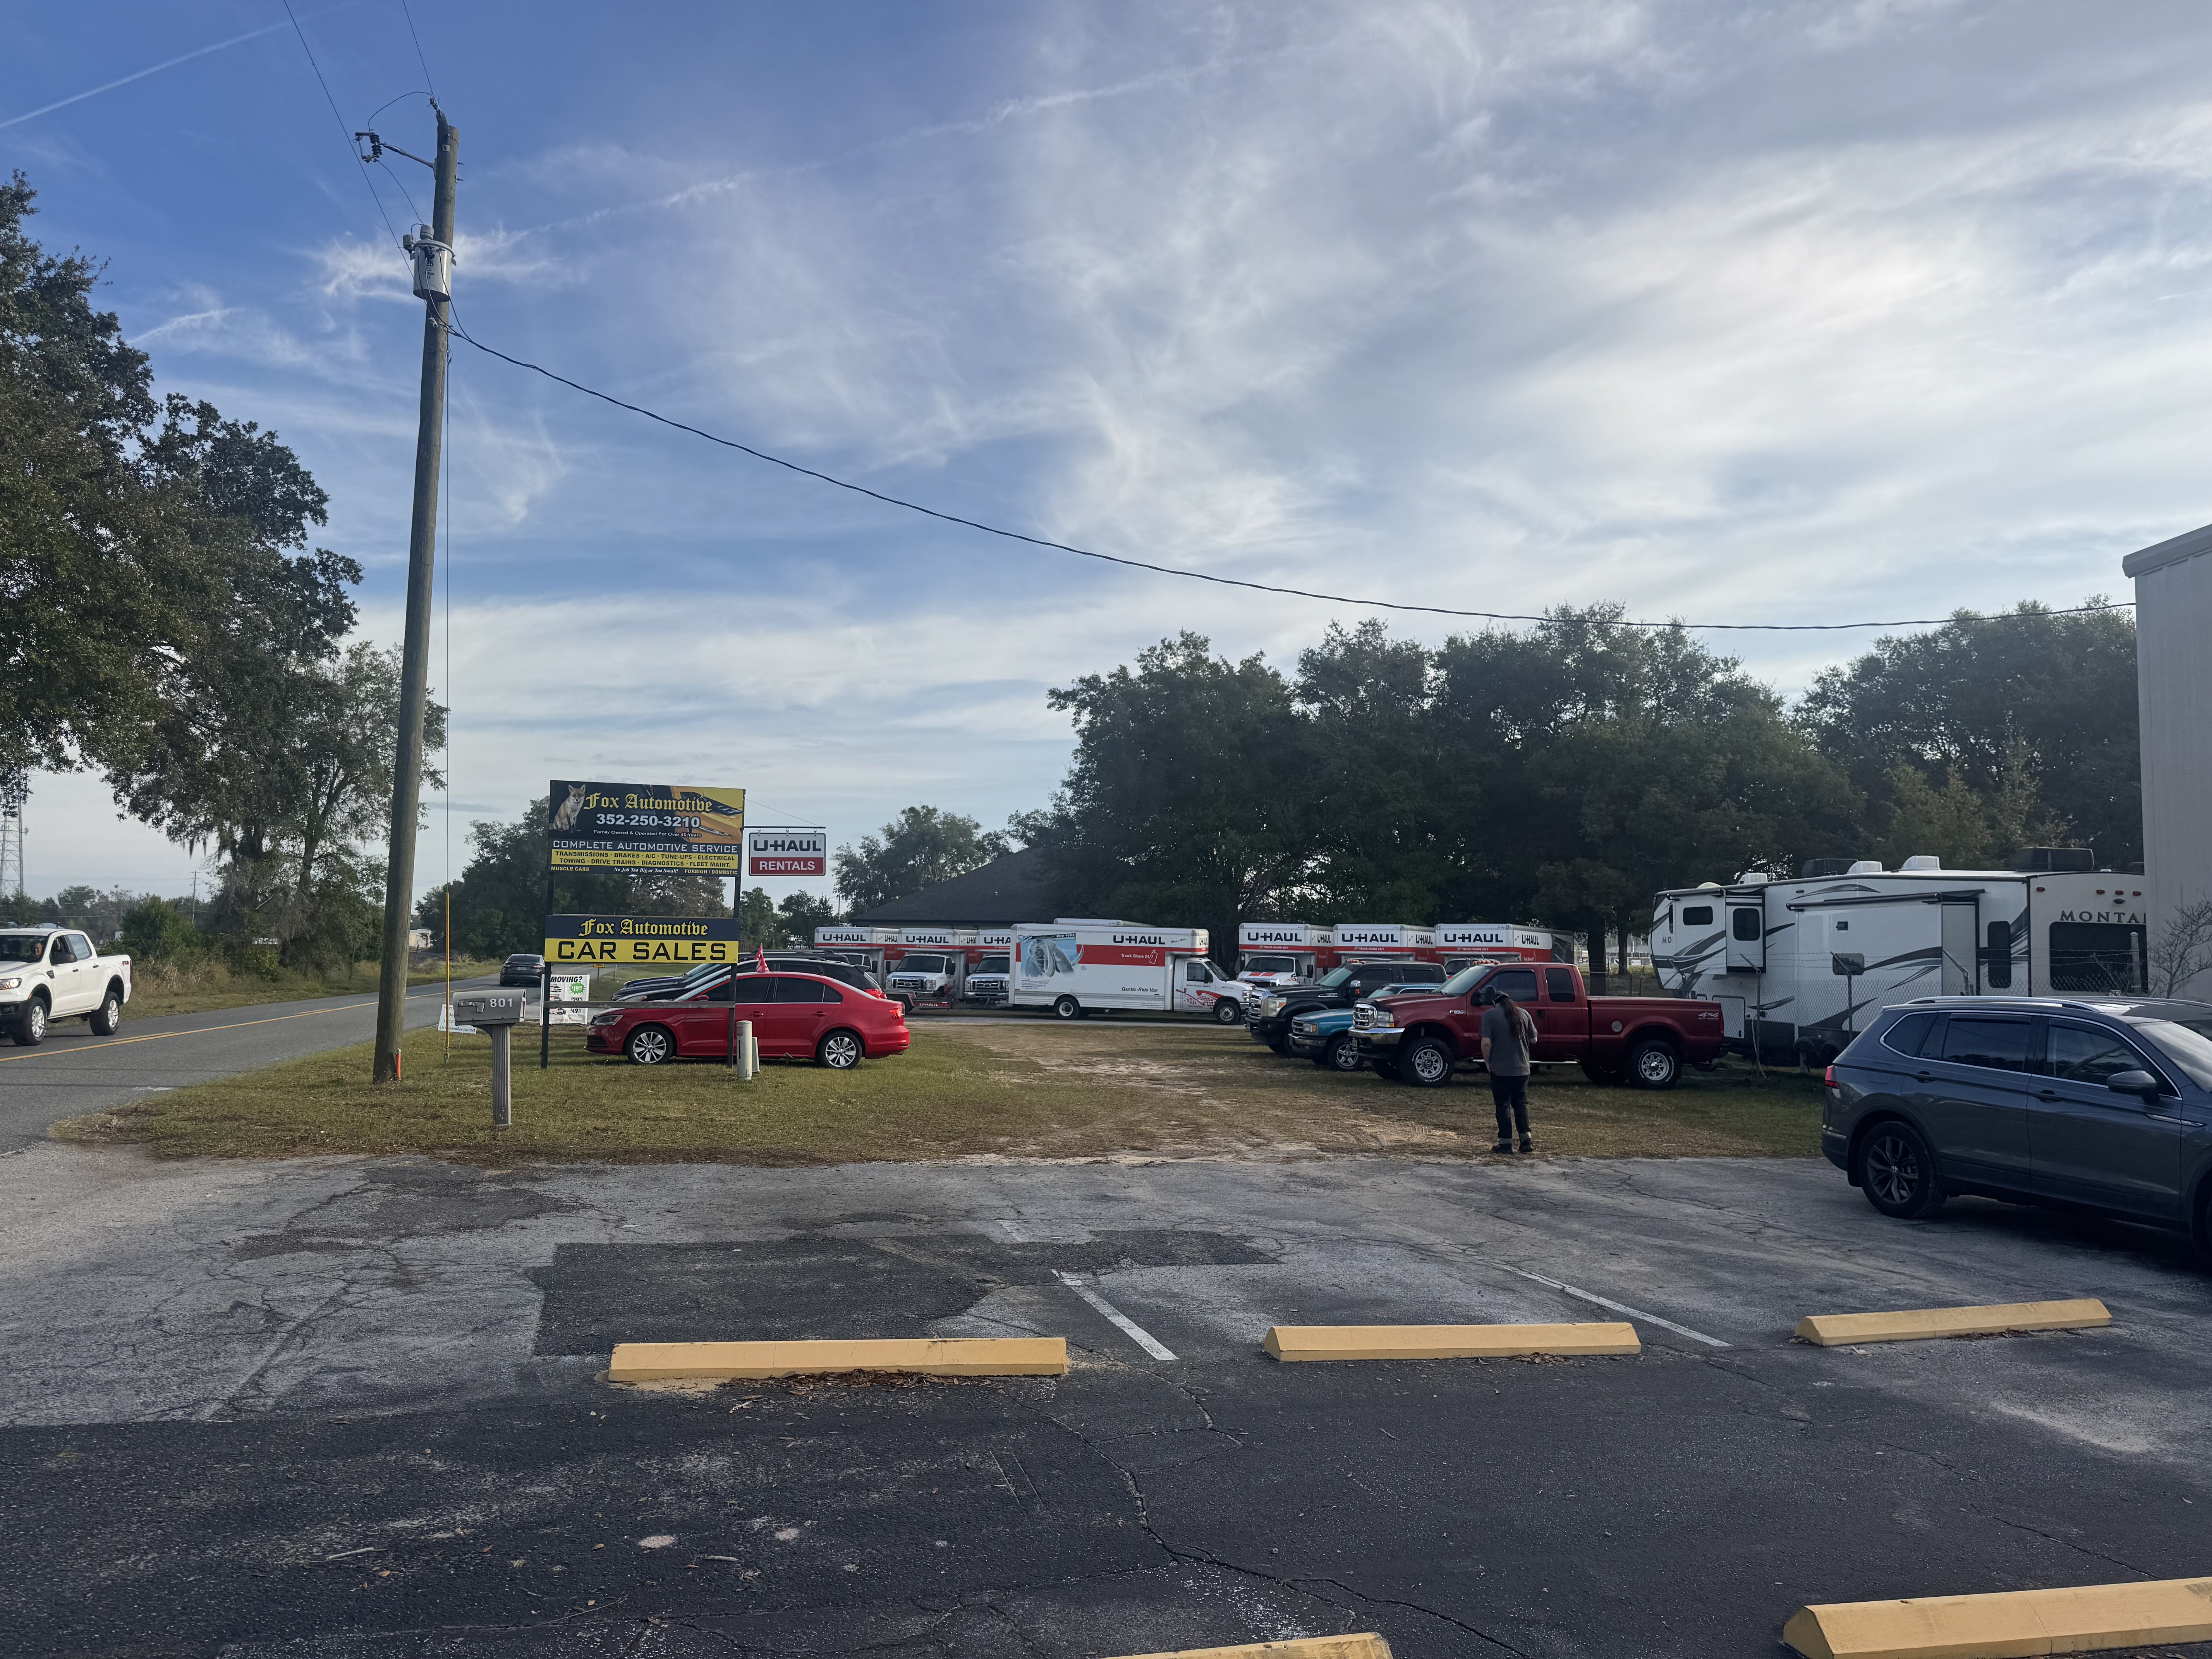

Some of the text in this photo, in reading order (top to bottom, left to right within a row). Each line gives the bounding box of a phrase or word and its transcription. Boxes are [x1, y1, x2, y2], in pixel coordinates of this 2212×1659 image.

[584, 792, 712, 812] Fox Automotive
[596, 814, 700, 828] 352-250-3210
[553, 840, 737, 853] COMPLETE AUTOMOTIVE SERVICE
[754, 840, 821, 851] U-HAUL
[759, 861, 815, 870] RENTALS
[578, 919, 708, 936] Fox Automotive
[906, 935, 949, 943] U-HAUL
[1113, 935, 1166, 945] U-HAUL
[1247, 932, 1302, 942] U-HAUL
[1317, 934, 1331, 943] U-HAUL
[1342, 933, 1398, 943] U-HAUL
[1416, 934, 1433, 945] U-HAUL
[1444, 933, 1503, 943] U-HAUL
[1522, 934, 1539, 945] U-HAUL
[558, 941, 726, 960] CAR SALES
[490, 998, 512, 1007] 801
